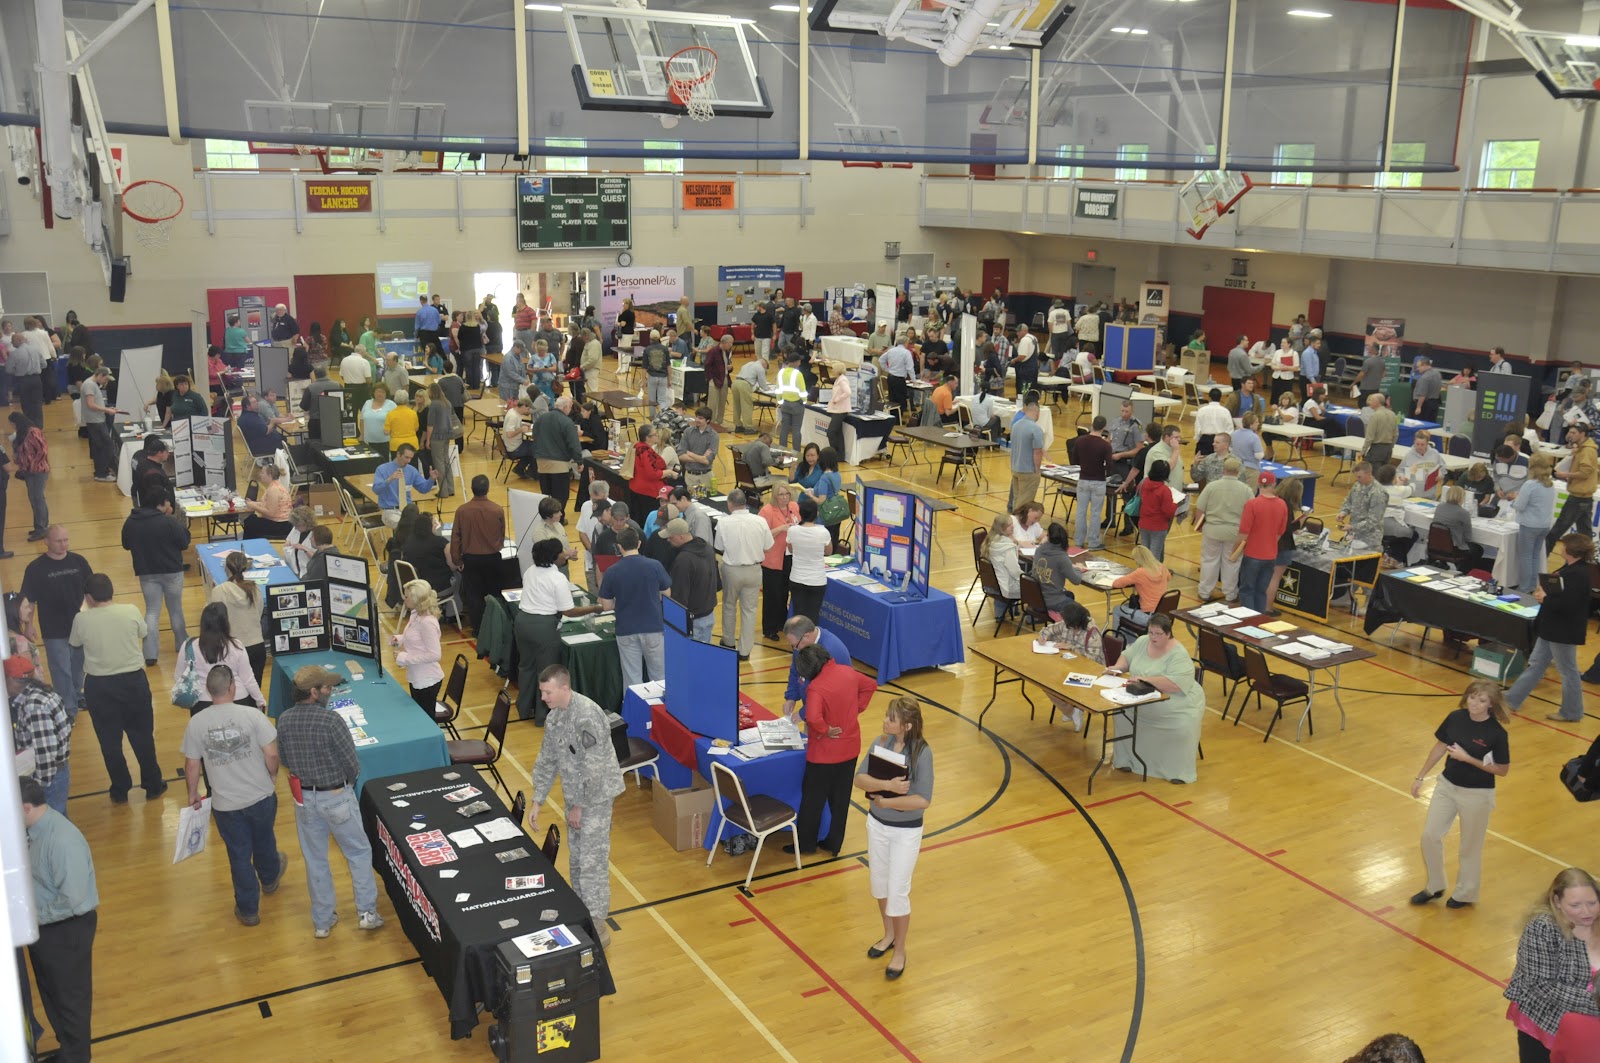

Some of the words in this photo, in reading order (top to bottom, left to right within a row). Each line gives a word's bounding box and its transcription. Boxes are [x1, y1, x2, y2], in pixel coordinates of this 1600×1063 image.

[309, 186, 339, 195] FEDERAL
[340, 186, 368, 195] HOCKING
[321, 198, 358, 208] LANCERS
[696, 197, 721, 206] BUCKEYES
[1080, 192, 1090, 202] OHIO
[1091, 193, 1116, 203] UNIVERSITY
[1085, 203, 1109, 216] BOBCATS
[1225, 279, 1247, 288] COURT
[1251, 281, 1256, 289] 2
[822, 600, 842, 615] ATHENS
[843, 610, 864, 625] COUNTY
[819, 609, 844, 626] CHILDREN
[845, 621, 870, 639] SERVICES
[461, 888, 555, 912] NATIONALGUARD.com
